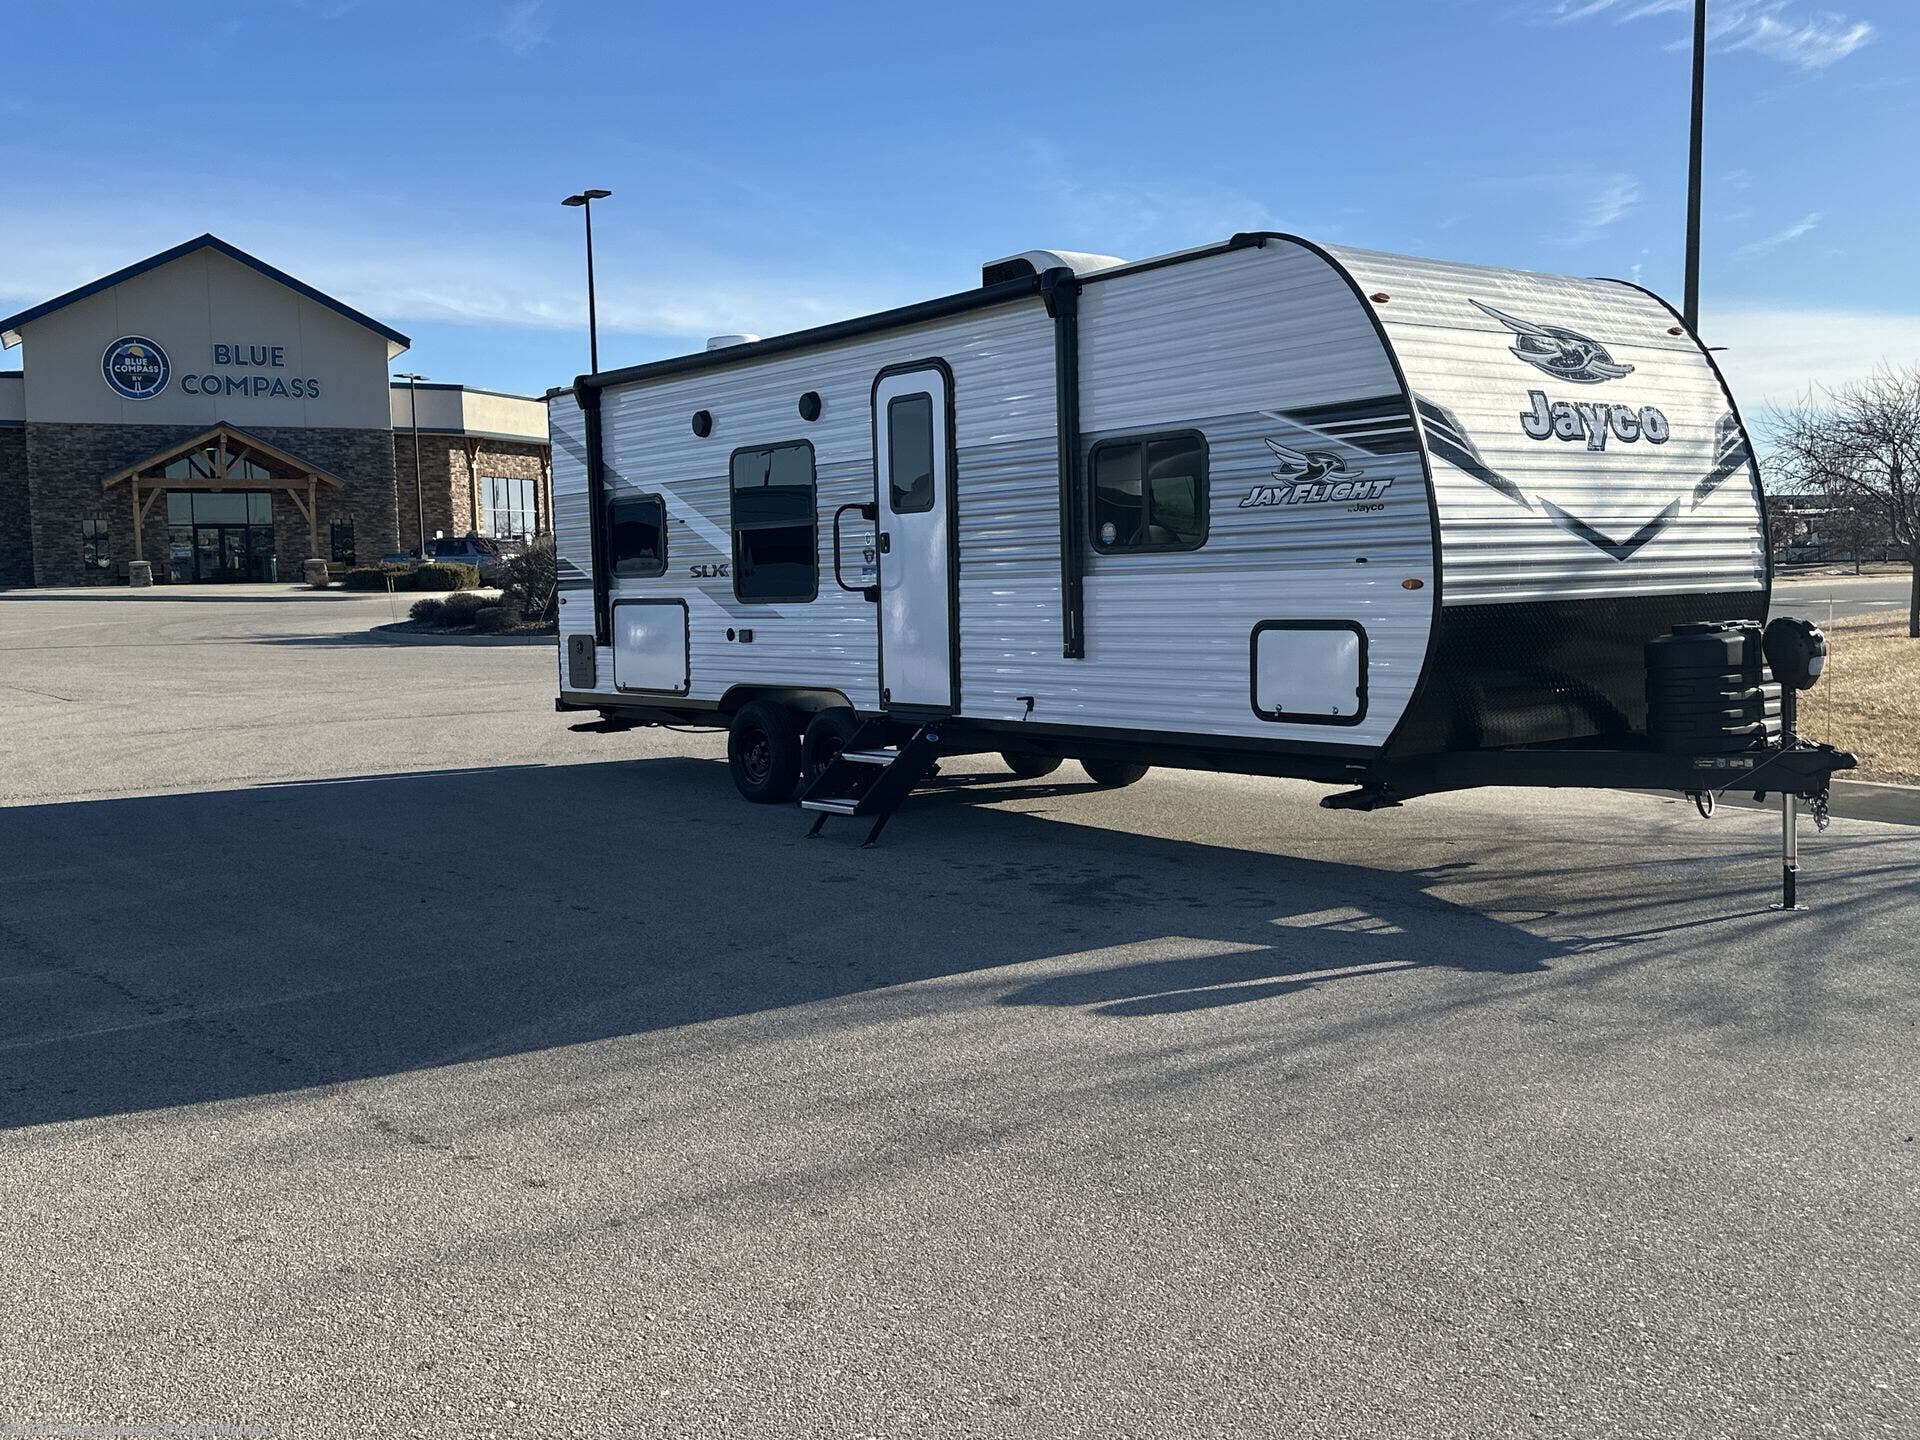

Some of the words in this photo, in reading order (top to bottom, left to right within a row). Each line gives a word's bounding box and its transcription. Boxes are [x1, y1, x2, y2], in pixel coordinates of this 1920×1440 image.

[124, 357, 148, 366] BLUE
[213, 344, 285, 367] BLUE
[114, 365, 159, 373] COMPASS
[180, 374, 320, 399] COMPASS
[1520, 389, 1670, 451] Jayco
[1239, 485, 1292, 508] JAY
[1288, 478, 1395, 504] FLIGHT
[1353, 503, 1385, 513] Jayco
